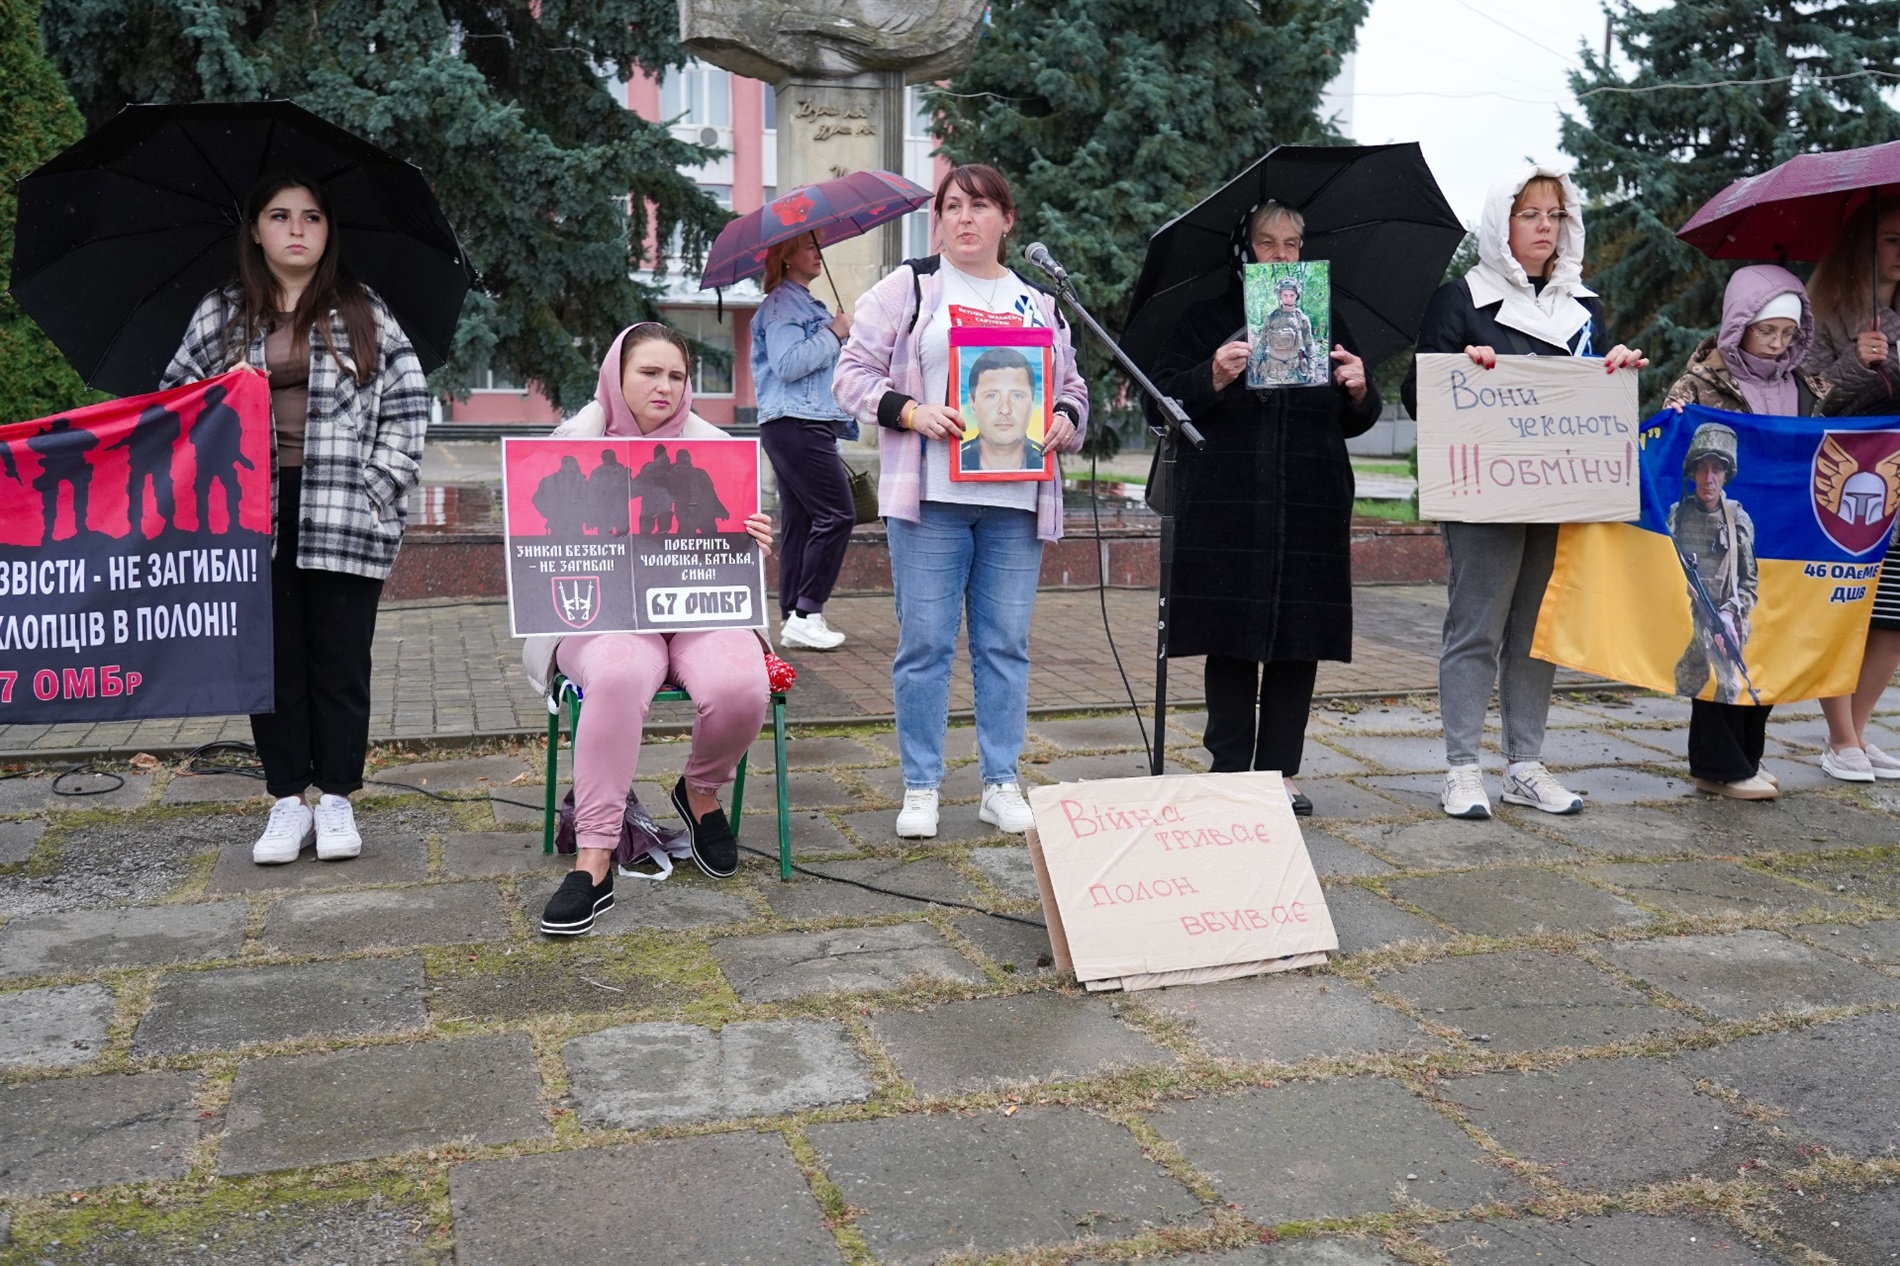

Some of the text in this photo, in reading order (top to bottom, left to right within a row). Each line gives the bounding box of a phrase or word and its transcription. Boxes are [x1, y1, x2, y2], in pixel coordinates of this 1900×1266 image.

[1450, 369, 1540, 411] Вони
[1508, 414, 1629, 437] чекають
[516, 544, 625, 557] ЗНИКЛІ БЕЗВІСТИ
[664, 538, 730, 551] ПОВЕРНІТЬ
[540, 560, 556, 572] НЕ
[560, 559, 615, 572] ЗАГИБЛІ!
[640, 552, 755, 567] ЧОЛОВІКА, БАТЬКА,
[109, 555, 141, 591] НЕ
[147, 549, 257, 588] ЗАГИБЛІ!
[681, 568, 716, 580] СИНА!
[1803, 563, 1827, 578] 46
[651, 591, 748, 616] 67 ОМБР
[1830, 586, 1867, 603] ДШВ
[113, 609, 129, 644] В
[137, 601, 238, 640] ПОЛОНІ!
[0, 670, 18, 703] 7
[1060, 799, 1185, 838] Війна
